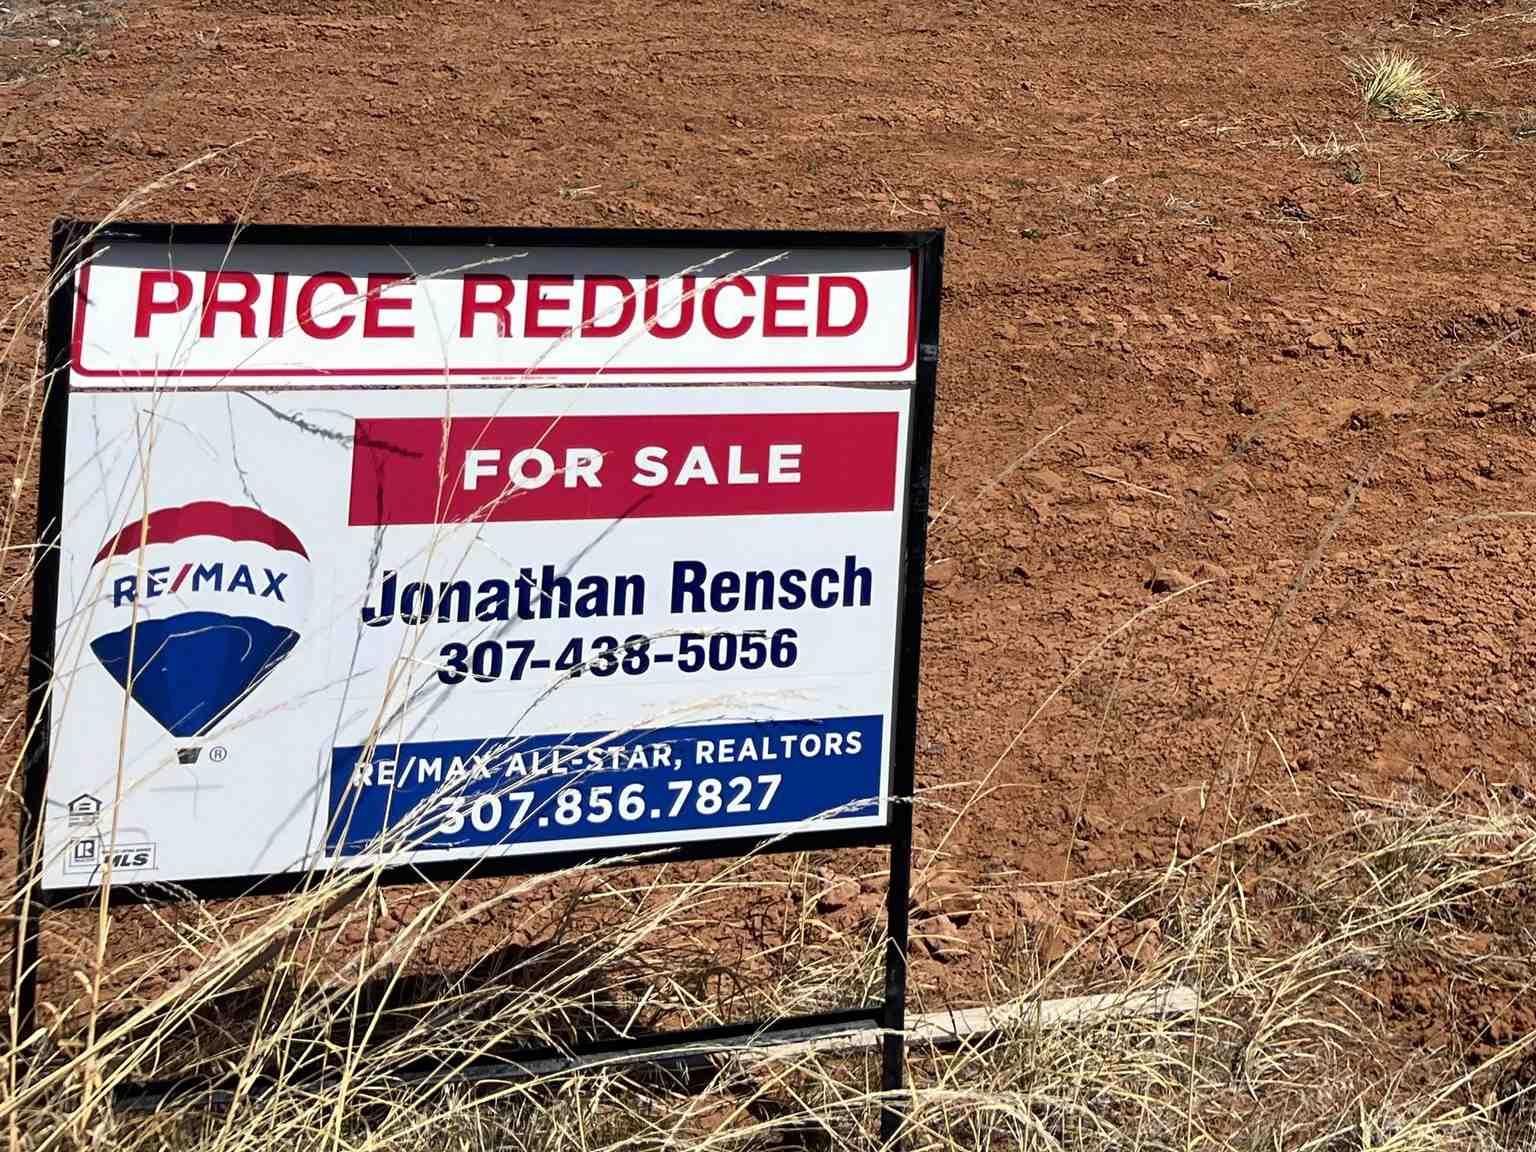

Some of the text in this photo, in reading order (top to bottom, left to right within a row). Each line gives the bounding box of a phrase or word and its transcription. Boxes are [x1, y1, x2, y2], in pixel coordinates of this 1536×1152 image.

[133, 270, 869, 340] PRICE REDUCED
[463, 443, 803, 491] FOR SALE
[113, 562, 289, 609] RE/MAX
[361, 555, 873, 627] Jonathan Rensch
[438, 627, 799, 686] 307-438-5056
[353, 730, 863, 789] RE/MAX ALL-STAR, REALTORS
[438, 773, 783, 835] 307.856.7827
